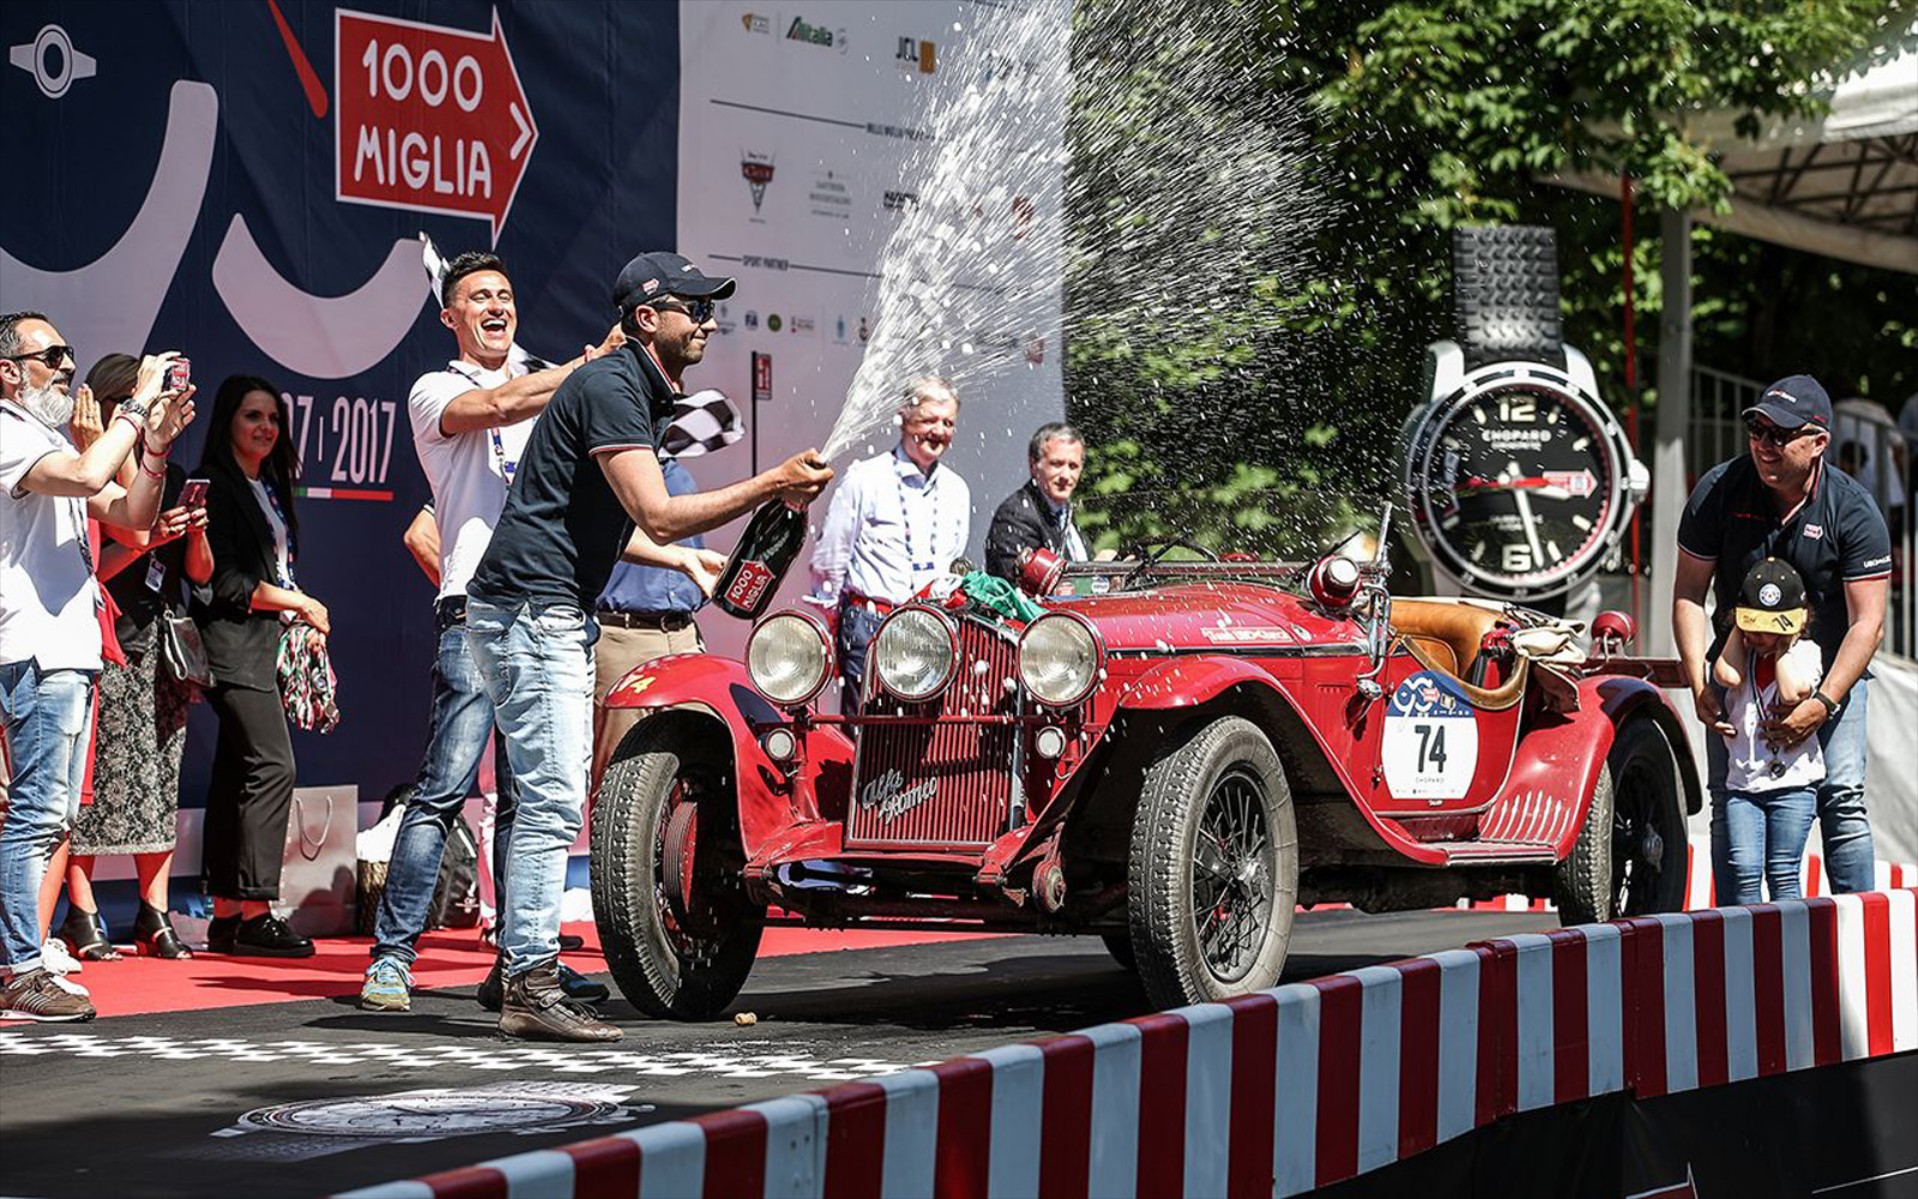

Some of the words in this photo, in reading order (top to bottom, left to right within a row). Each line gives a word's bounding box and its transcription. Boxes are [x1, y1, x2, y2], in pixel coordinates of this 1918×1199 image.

[362, 39, 484, 112] 1000
[354, 124, 492, 199] MIGLIA
[743, 255, 762, 268] SPORT
[763, 258, 789, 271] PARTNER
[1500, 396, 1536, 423] 12
[331, 396, 397, 484] 2017
[1481, 428, 1552, 443] CHOPARD
[1502, 543, 1532, 572] 6
[731, 570, 754, 600] 1000
[1772, 614, 1795, 632] 74
[1415, 724, 1447, 774] 74
